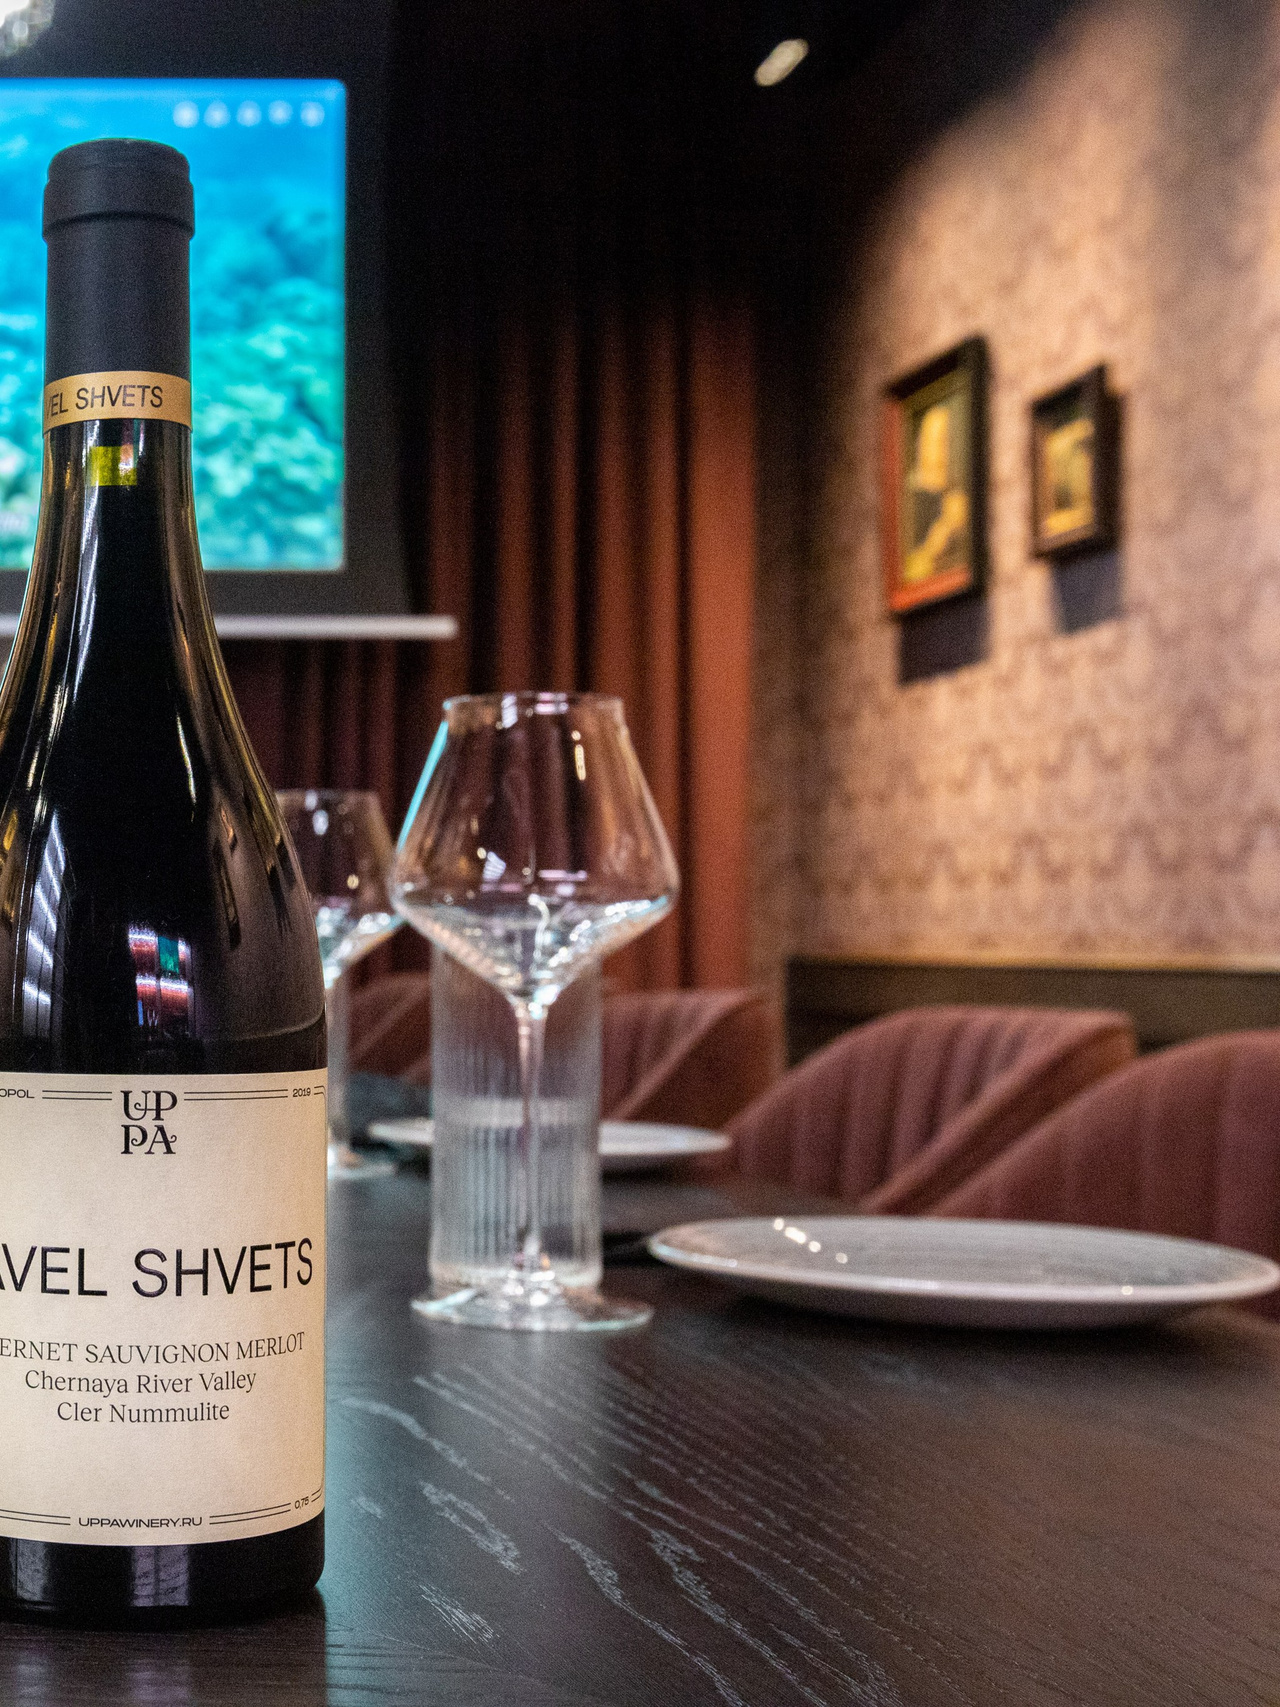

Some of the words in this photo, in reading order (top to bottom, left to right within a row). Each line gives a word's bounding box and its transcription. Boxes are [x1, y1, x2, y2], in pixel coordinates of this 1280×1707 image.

[75, 384, 164, 410] SHVETS
[292, 1087, 312, 1098] 2019
[132, 1237, 313, 1298] SHVETS
[85, 1342, 231, 1365] SAUVIGNON
[236, 1331, 306, 1361] MERLOT
[24, 1369, 129, 1398] Chernaya
[136, 1375, 194, 1394] River
[199, 1371, 257, 1394] Valley
[56, 1401, 103, 1422] Cler
[109, 1403, 231, 1424] Nummulite
[294, 1496, 310, 1510] 0,75
[78, 1516, 203, 1529] UPPAWINERY.RU
